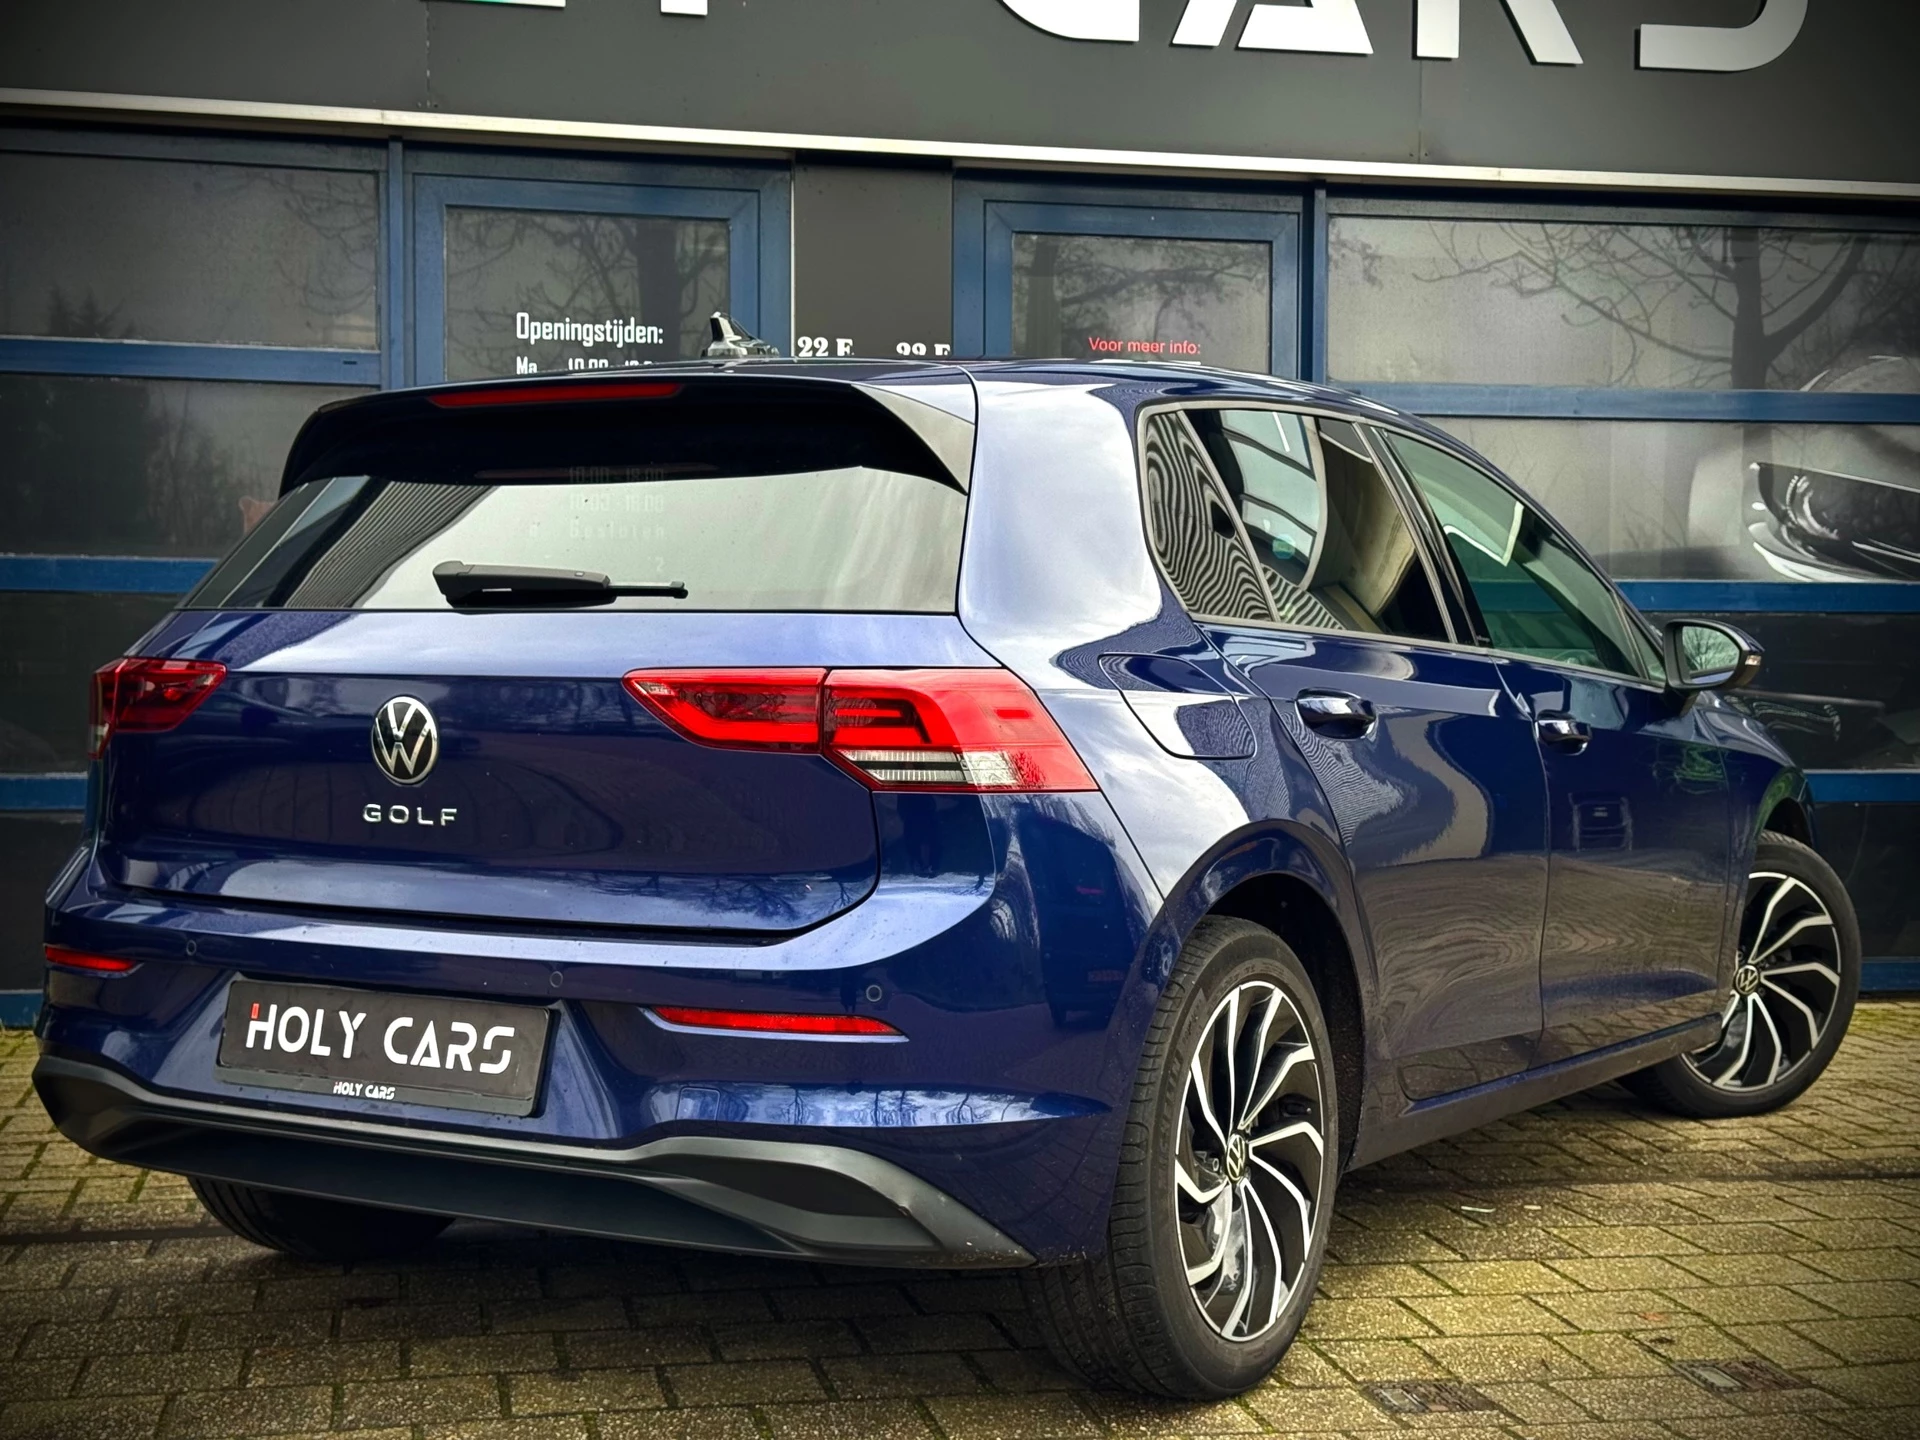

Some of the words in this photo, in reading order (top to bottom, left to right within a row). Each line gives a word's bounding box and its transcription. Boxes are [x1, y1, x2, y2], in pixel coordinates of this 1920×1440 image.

[516, 312, 664, 348] Openingstijden:
[797, 336, 828, 357] 22
[1088, 336, 1123, 351] Voor
[1127, 340, 1166, 353] meer
[1169, 339, 1201, 354] info:
[516, 356, 538, 375] Ma
[363, 803, 458, 826] GOLF
[245, 1003, 367, 1059] HOLY
[383, 1016, 515, 1075] CARS
[333, 1081, 363, 1097] HOLY
[365, 1084, 396, 1100] CARS
